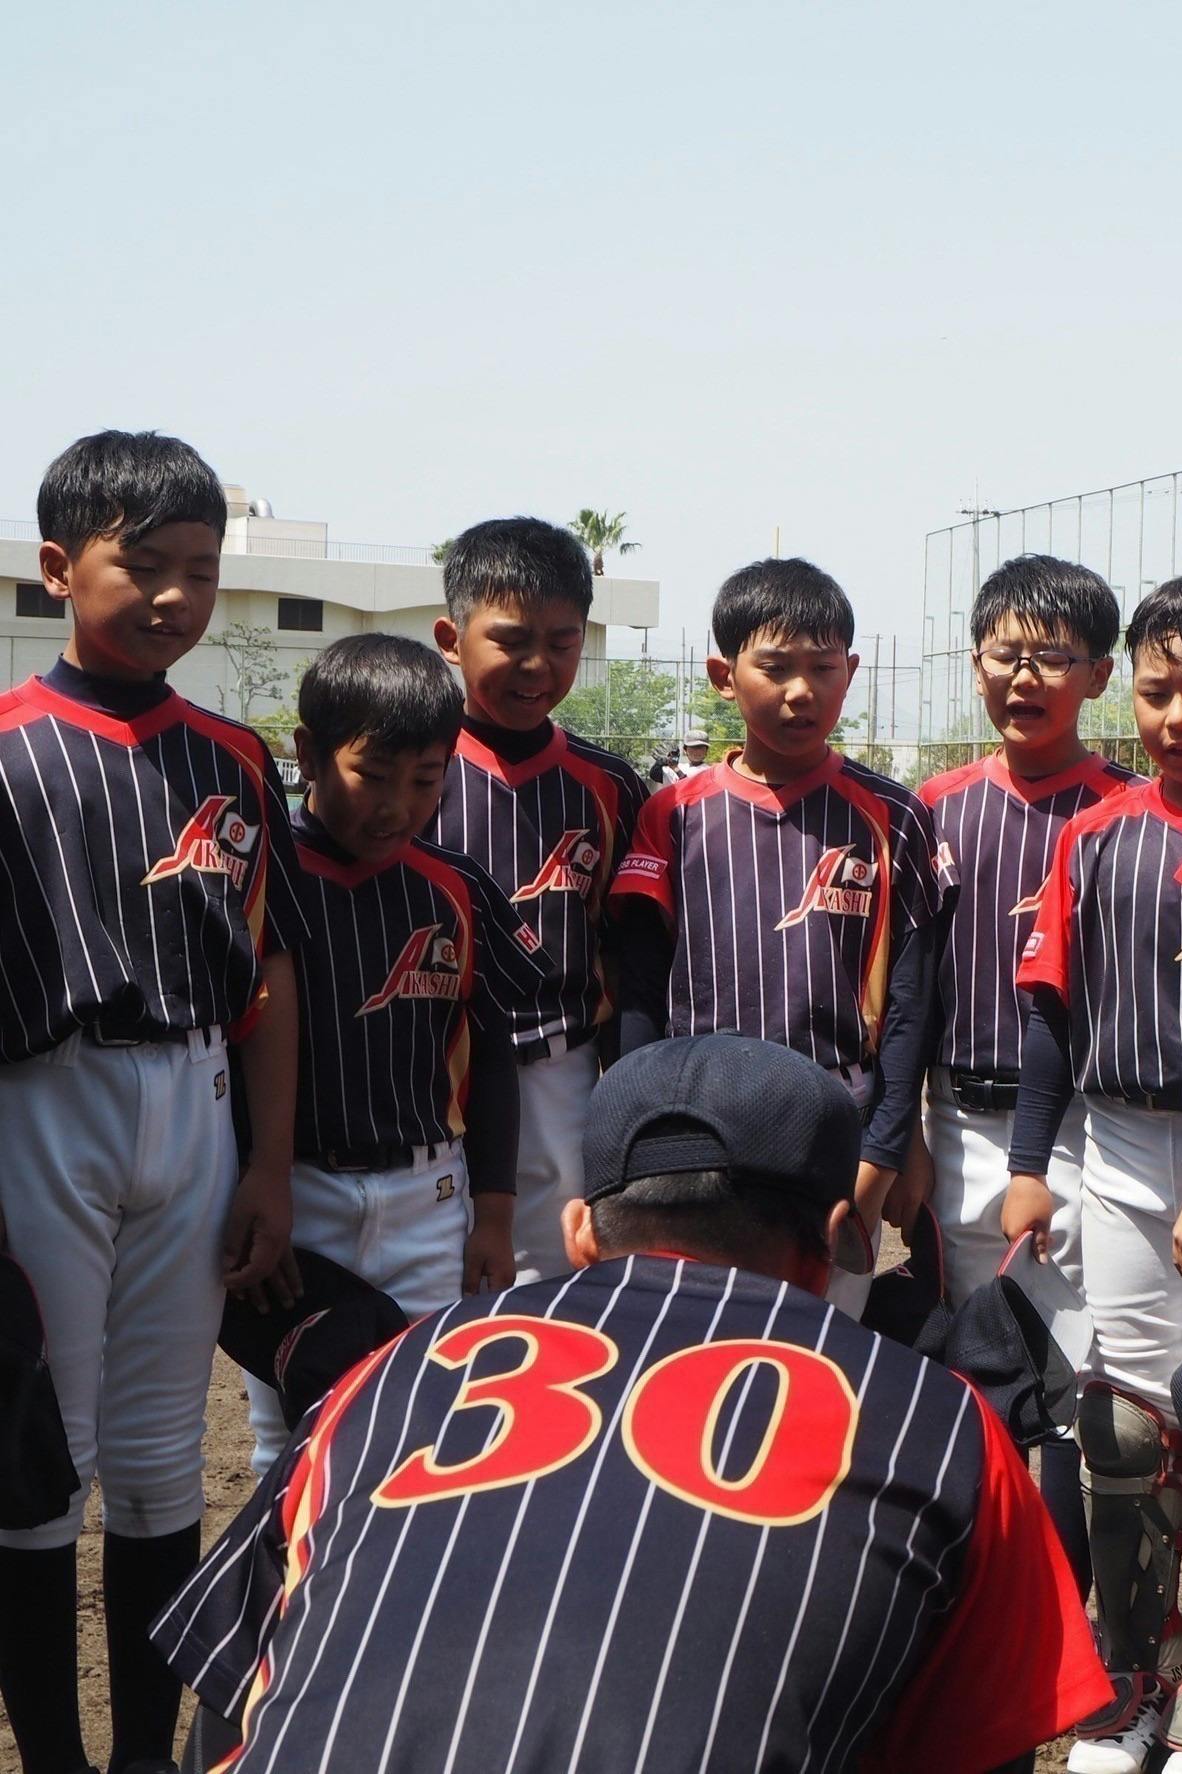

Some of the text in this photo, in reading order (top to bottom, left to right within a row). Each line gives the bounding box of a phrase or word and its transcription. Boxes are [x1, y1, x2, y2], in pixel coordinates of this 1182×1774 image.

[631, 859, 659, 871] PLAYER
[773, 843, 872, 931] AKASHI
[370, 1314, 859, 1526] 30
